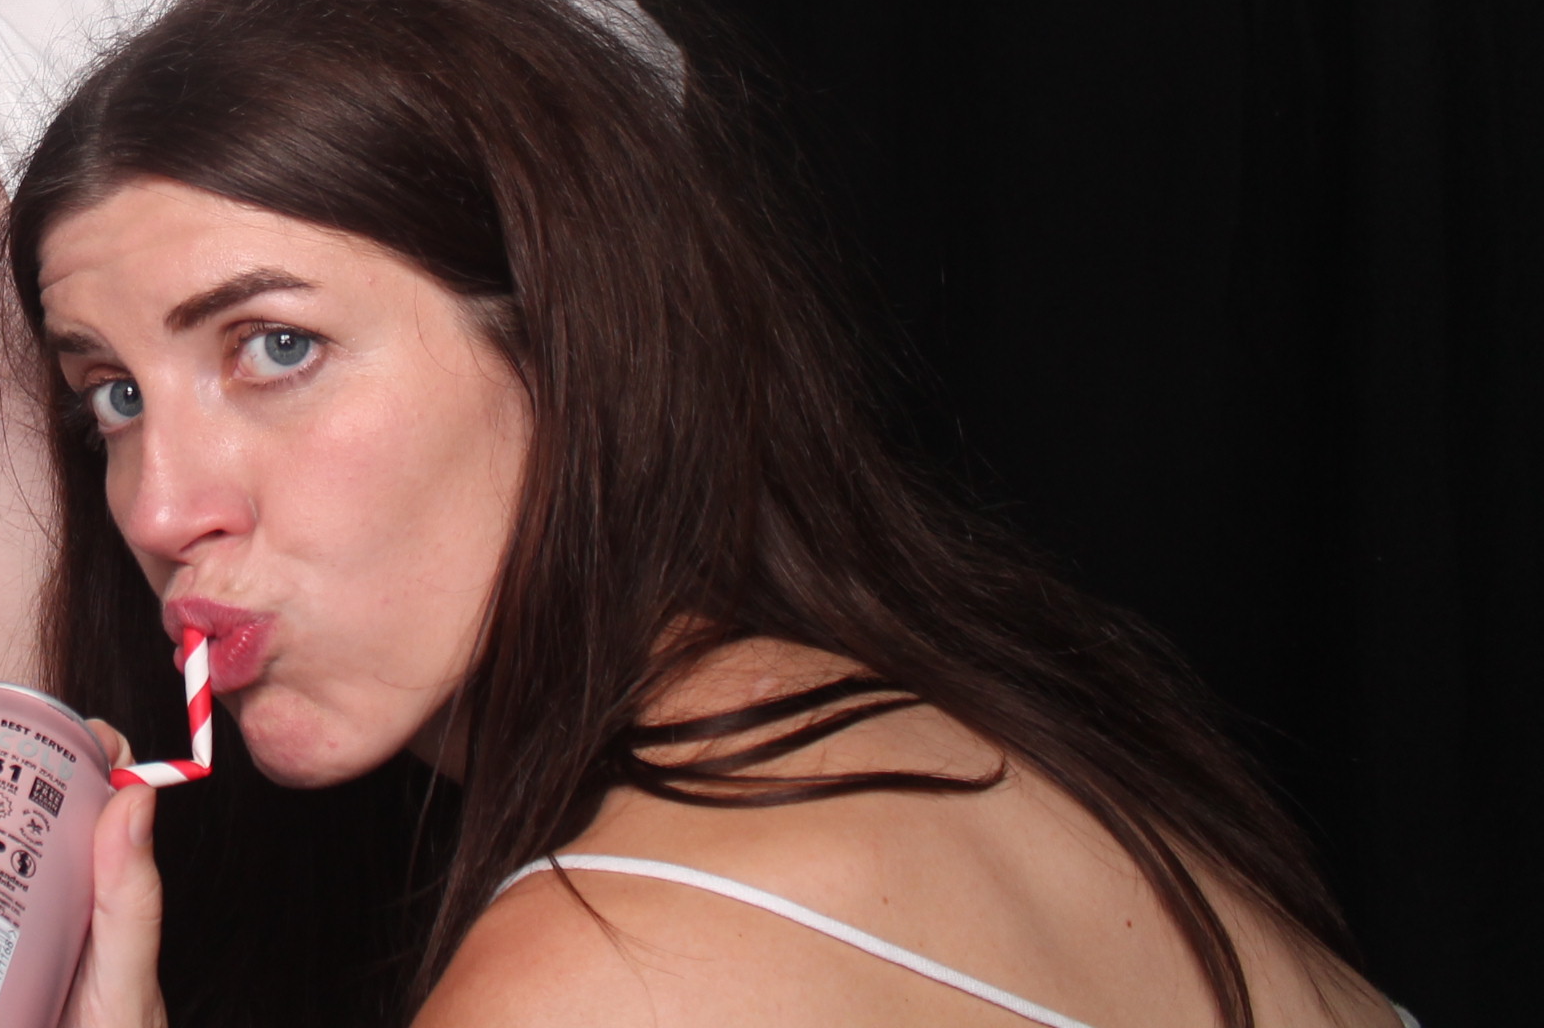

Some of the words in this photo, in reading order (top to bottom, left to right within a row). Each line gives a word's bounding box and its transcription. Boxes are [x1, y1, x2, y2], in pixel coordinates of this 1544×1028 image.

[0, 719, 31, 736] BEST
[34, 731, 78, 764] SERVED
[10, 754, 20, 763] IN
[20, 759, 38, 771] NEW
[38, 767, 69, 791] ZEALAND
[35, 784, 61, 806] FREE
[36, 778, 63, 800] GLUTEN
[32, 791, 58, 812] VEGAN
